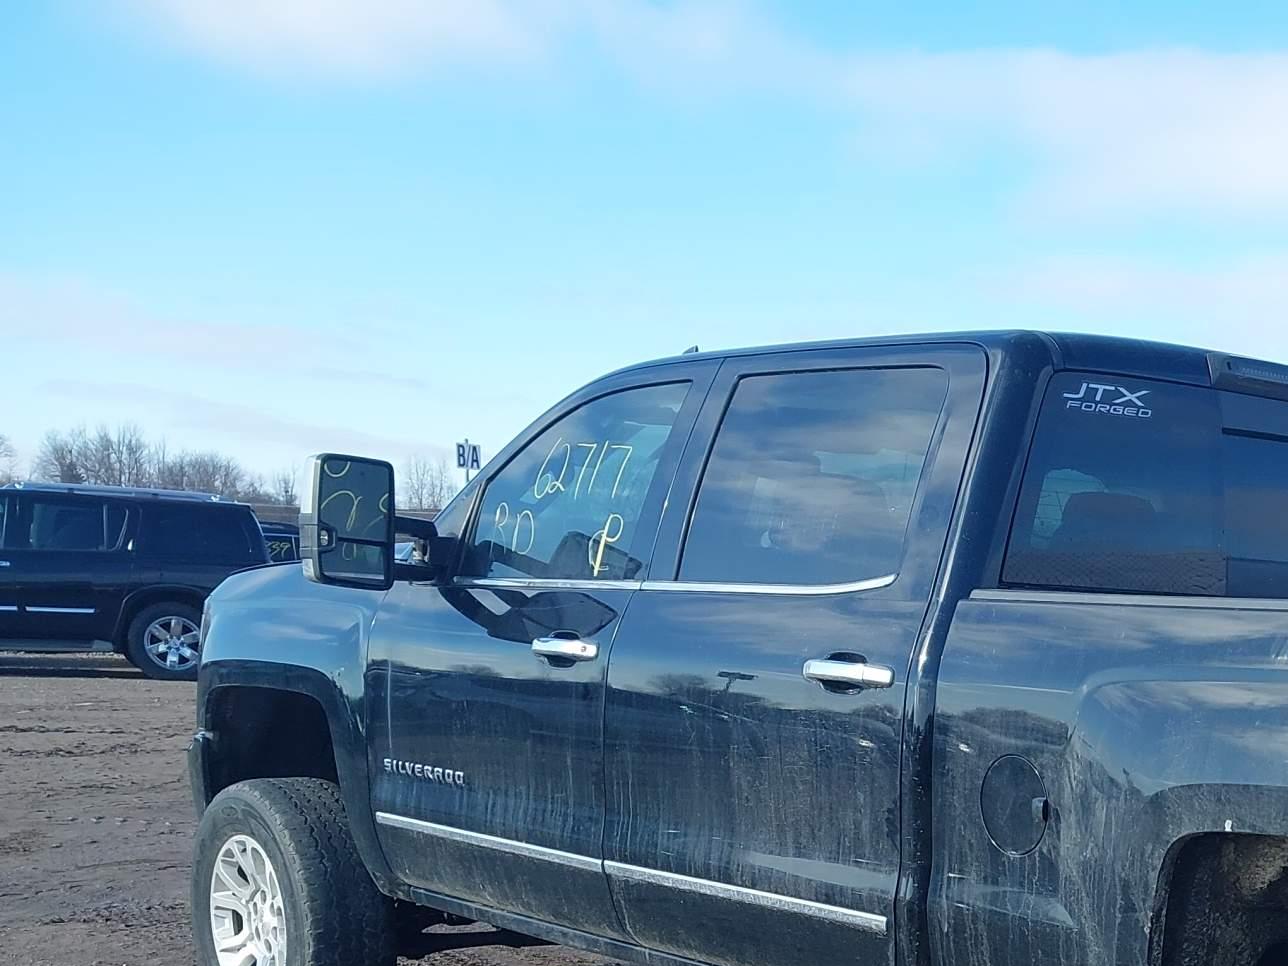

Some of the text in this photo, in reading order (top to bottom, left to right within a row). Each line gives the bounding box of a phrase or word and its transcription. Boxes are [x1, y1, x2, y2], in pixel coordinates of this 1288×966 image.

[1063, 382, 1152, 407] JTX
[1066, 400, 1152, 418] FORGED
[457, 443, 480, 469] B/A
[534, 437, 633, 500] 62717
[383, 758, 465, 787] SILVERADO
